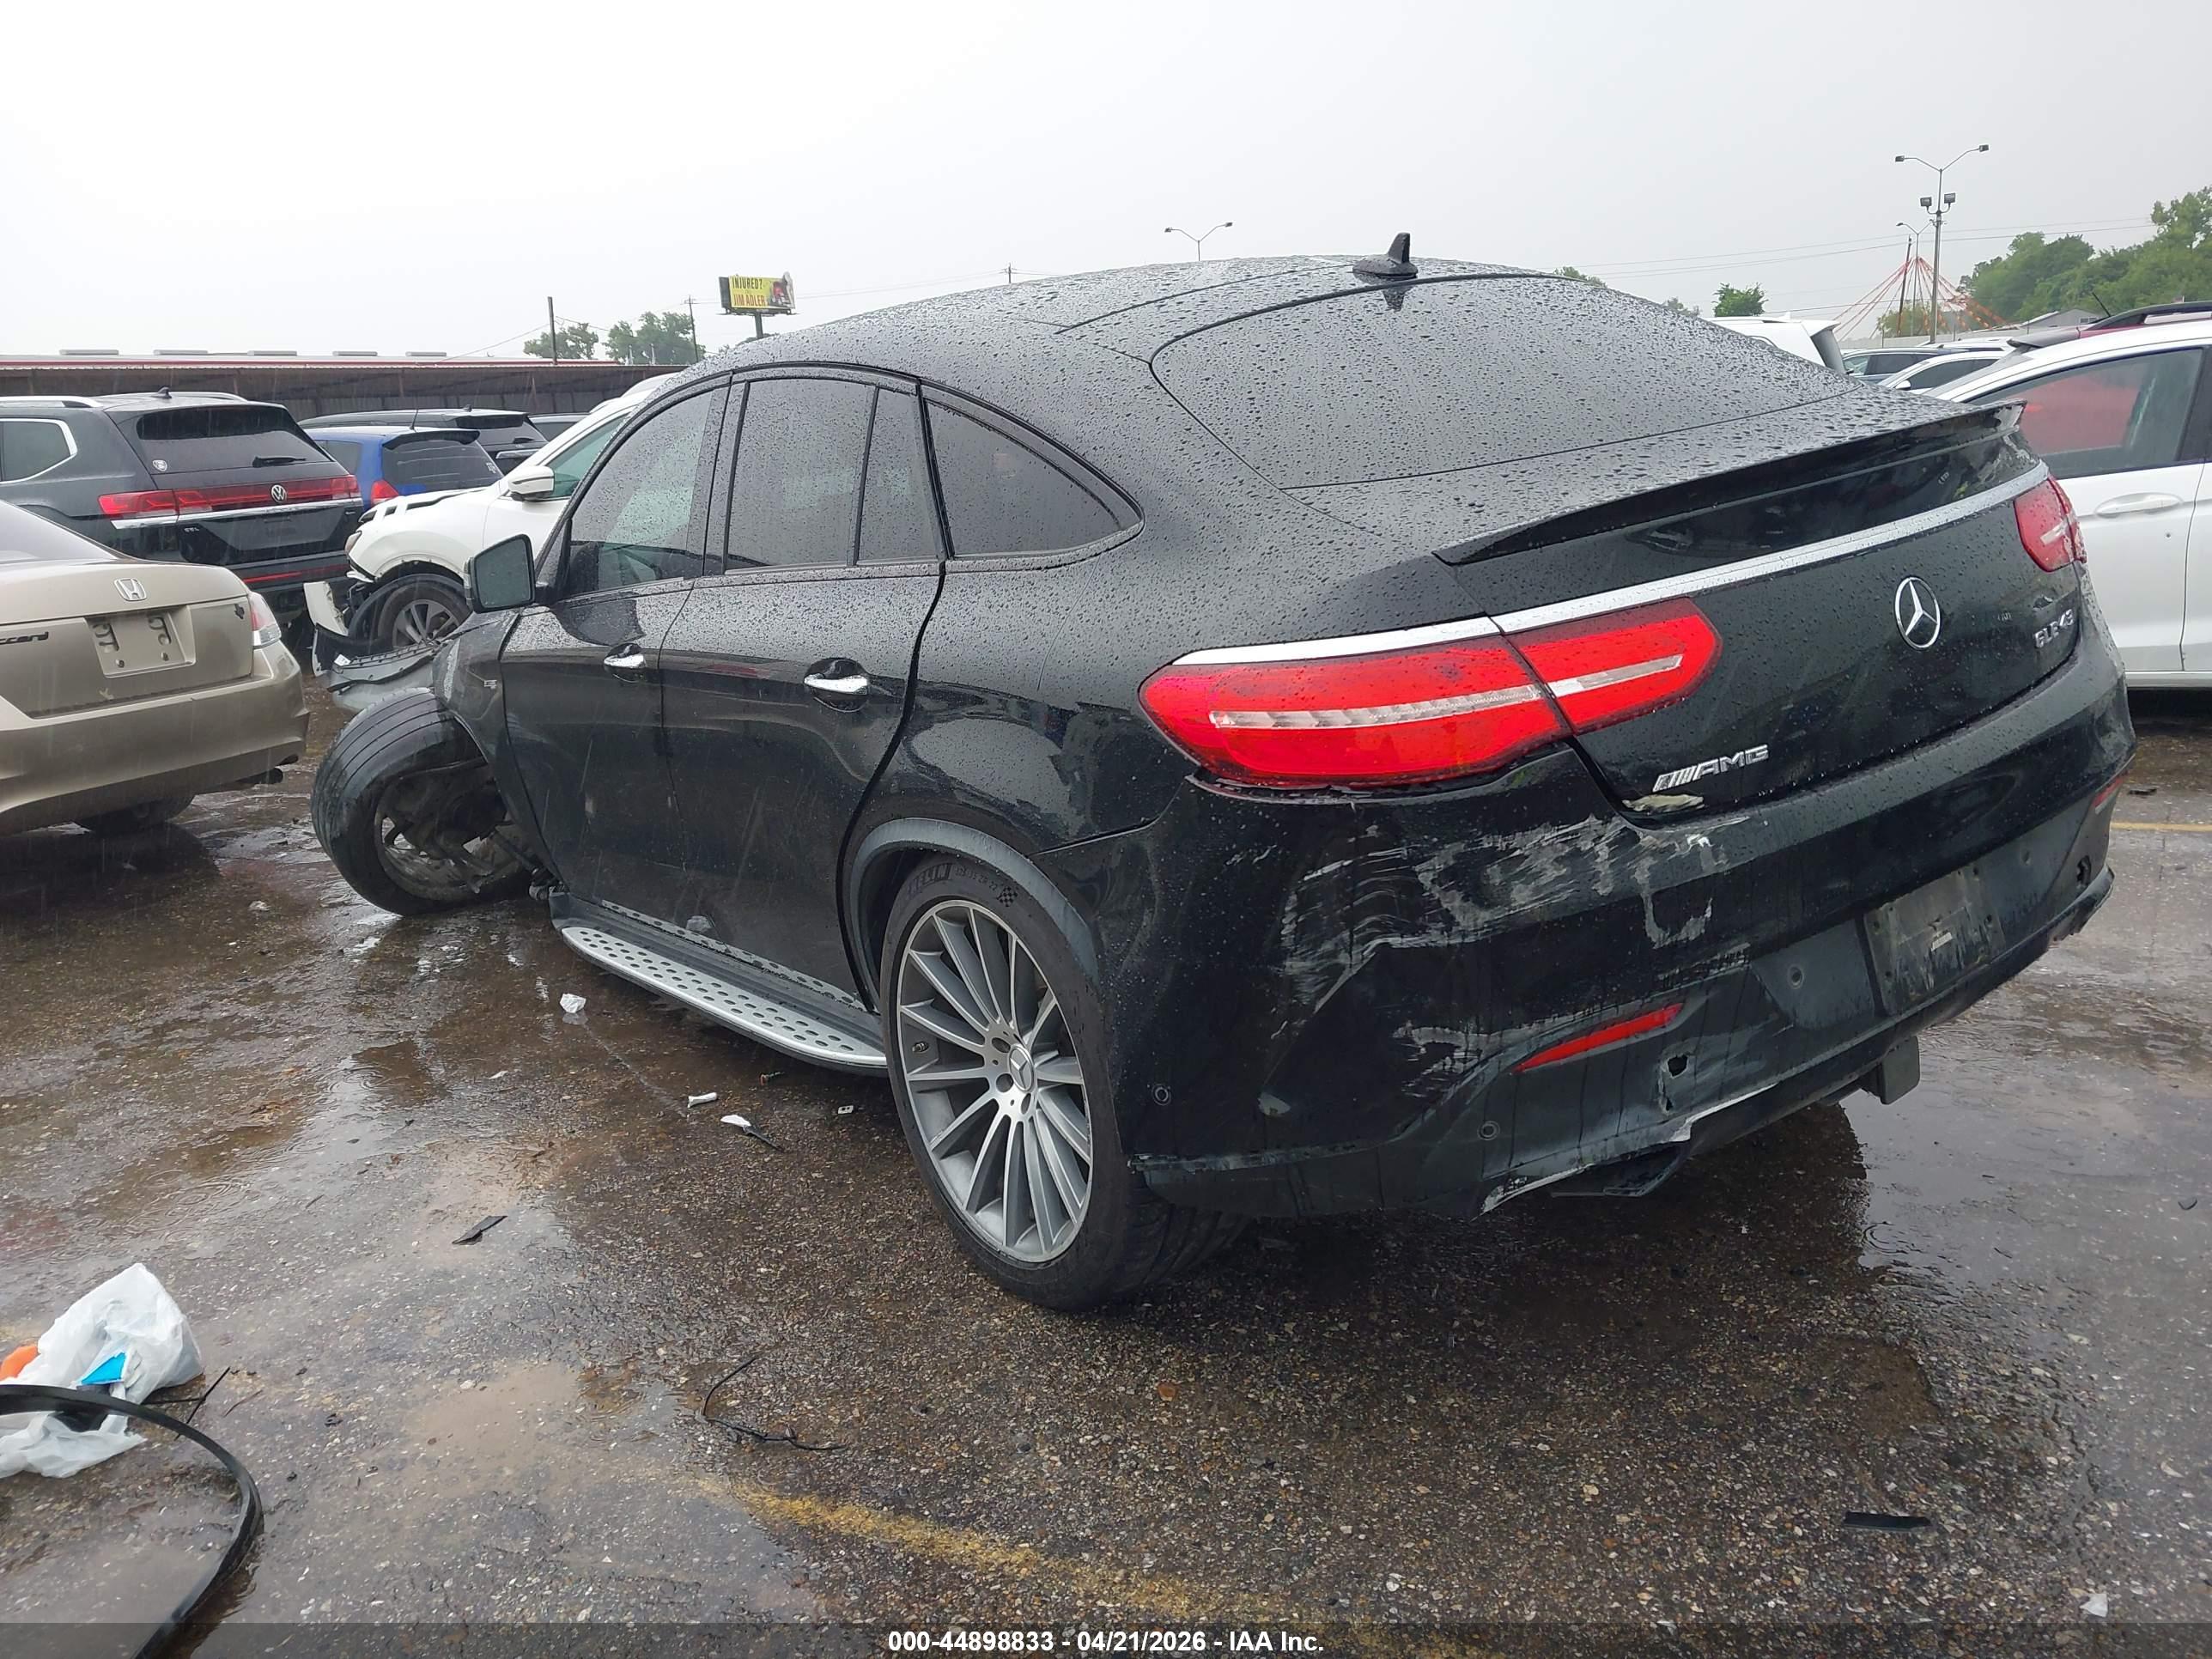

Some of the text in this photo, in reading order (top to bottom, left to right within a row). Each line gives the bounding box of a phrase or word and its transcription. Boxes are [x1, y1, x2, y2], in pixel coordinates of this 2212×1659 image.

[732, 277, 763, 289] INJURED?
[734, 295, 766, 307] JIM ADLER
